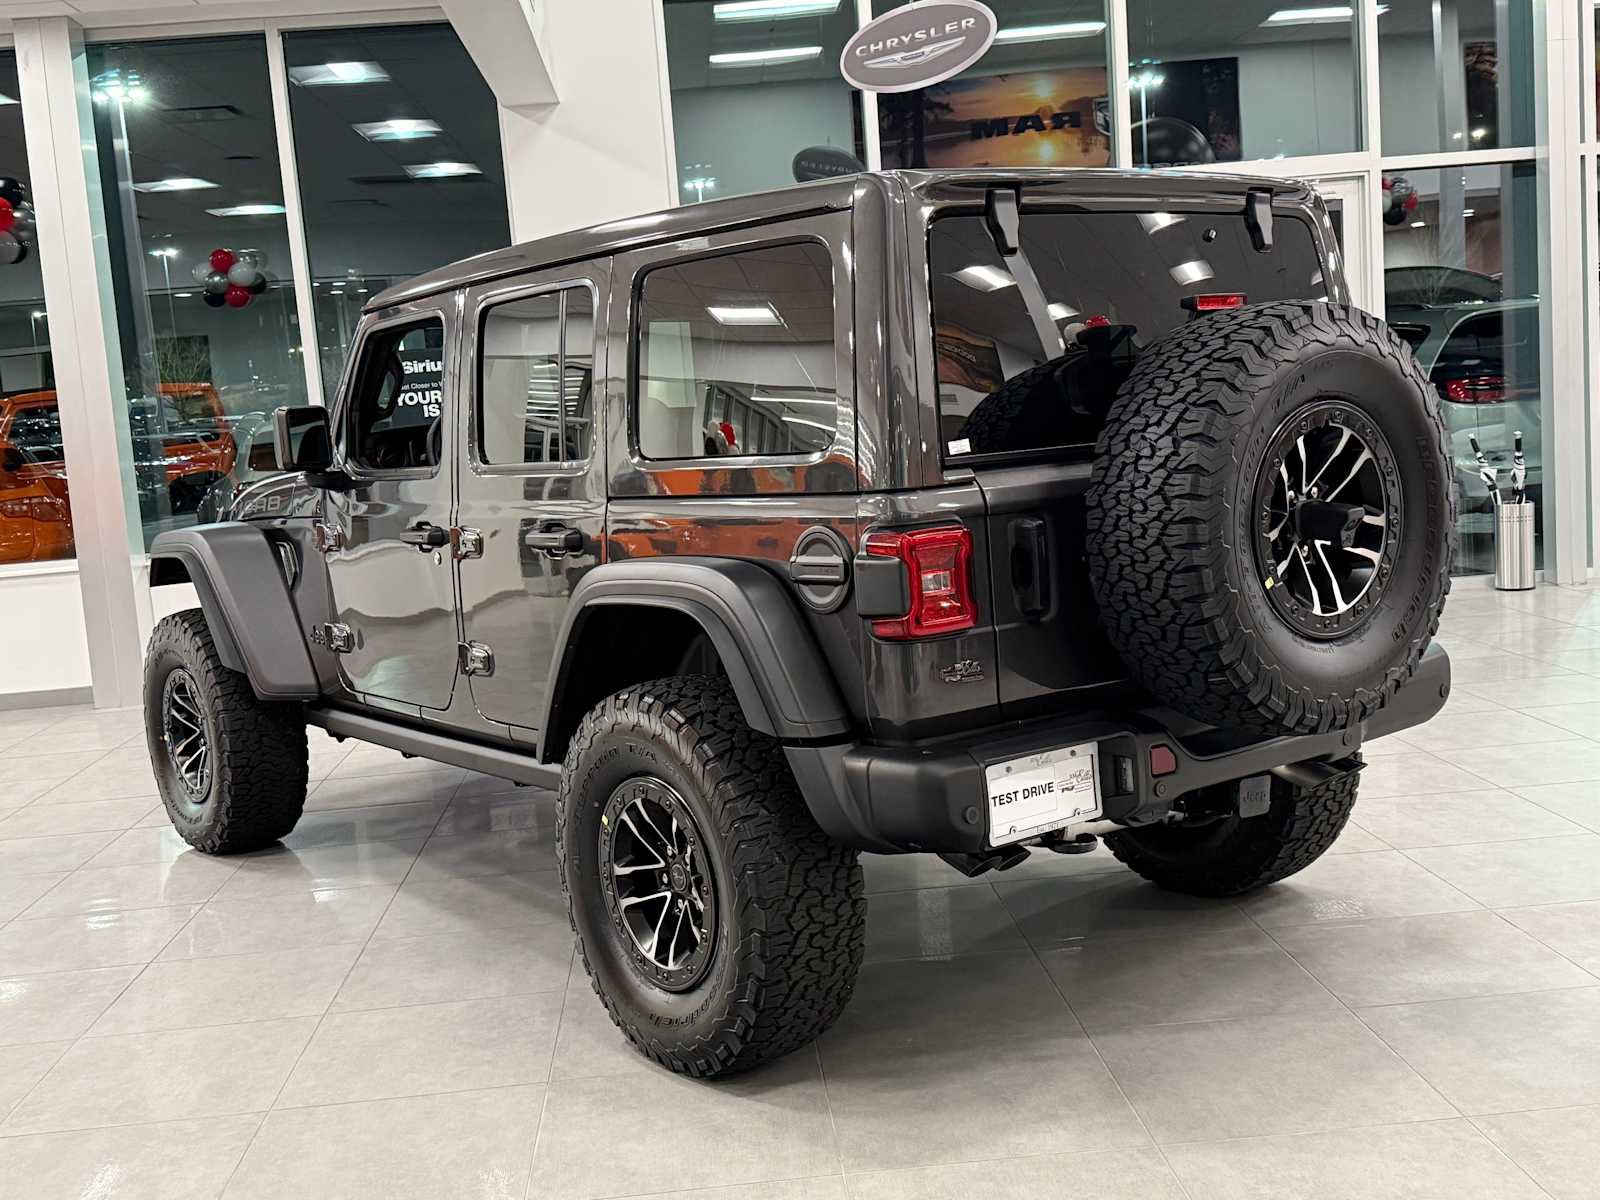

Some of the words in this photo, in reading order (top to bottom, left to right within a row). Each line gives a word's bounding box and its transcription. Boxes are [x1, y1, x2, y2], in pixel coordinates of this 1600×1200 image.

[855, 17, 976, 57] CHRYSLER
[402, 360, 442, 374] Siriu
[397, 390, 442, 406] YOUR
[991, 790, 1019, 807] TEST
[1022, 782, 1054, 799] DRIVE
